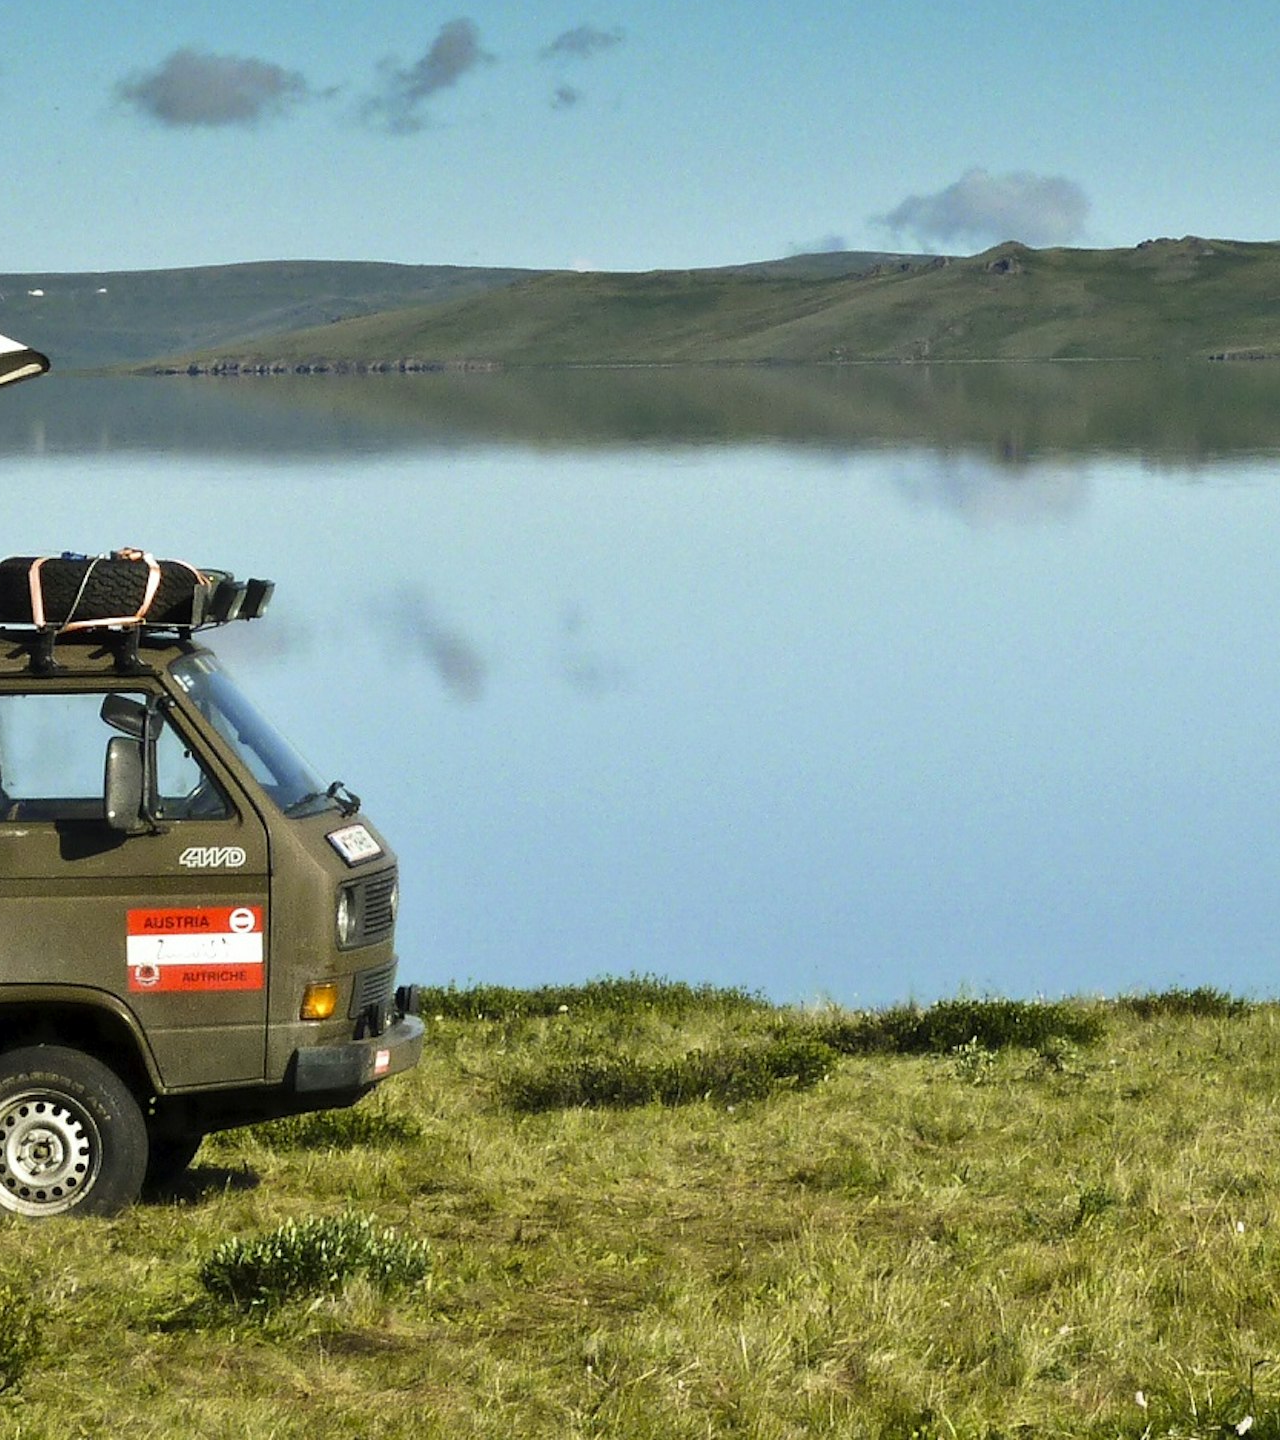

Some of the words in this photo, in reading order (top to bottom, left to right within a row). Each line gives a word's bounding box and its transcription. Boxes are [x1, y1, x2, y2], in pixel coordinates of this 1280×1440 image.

[179, 847, 246, 867] 4WD
[144, 916, 209, 929] AUSTRIA
[182, 970, 247, 983] AUTRICHE
